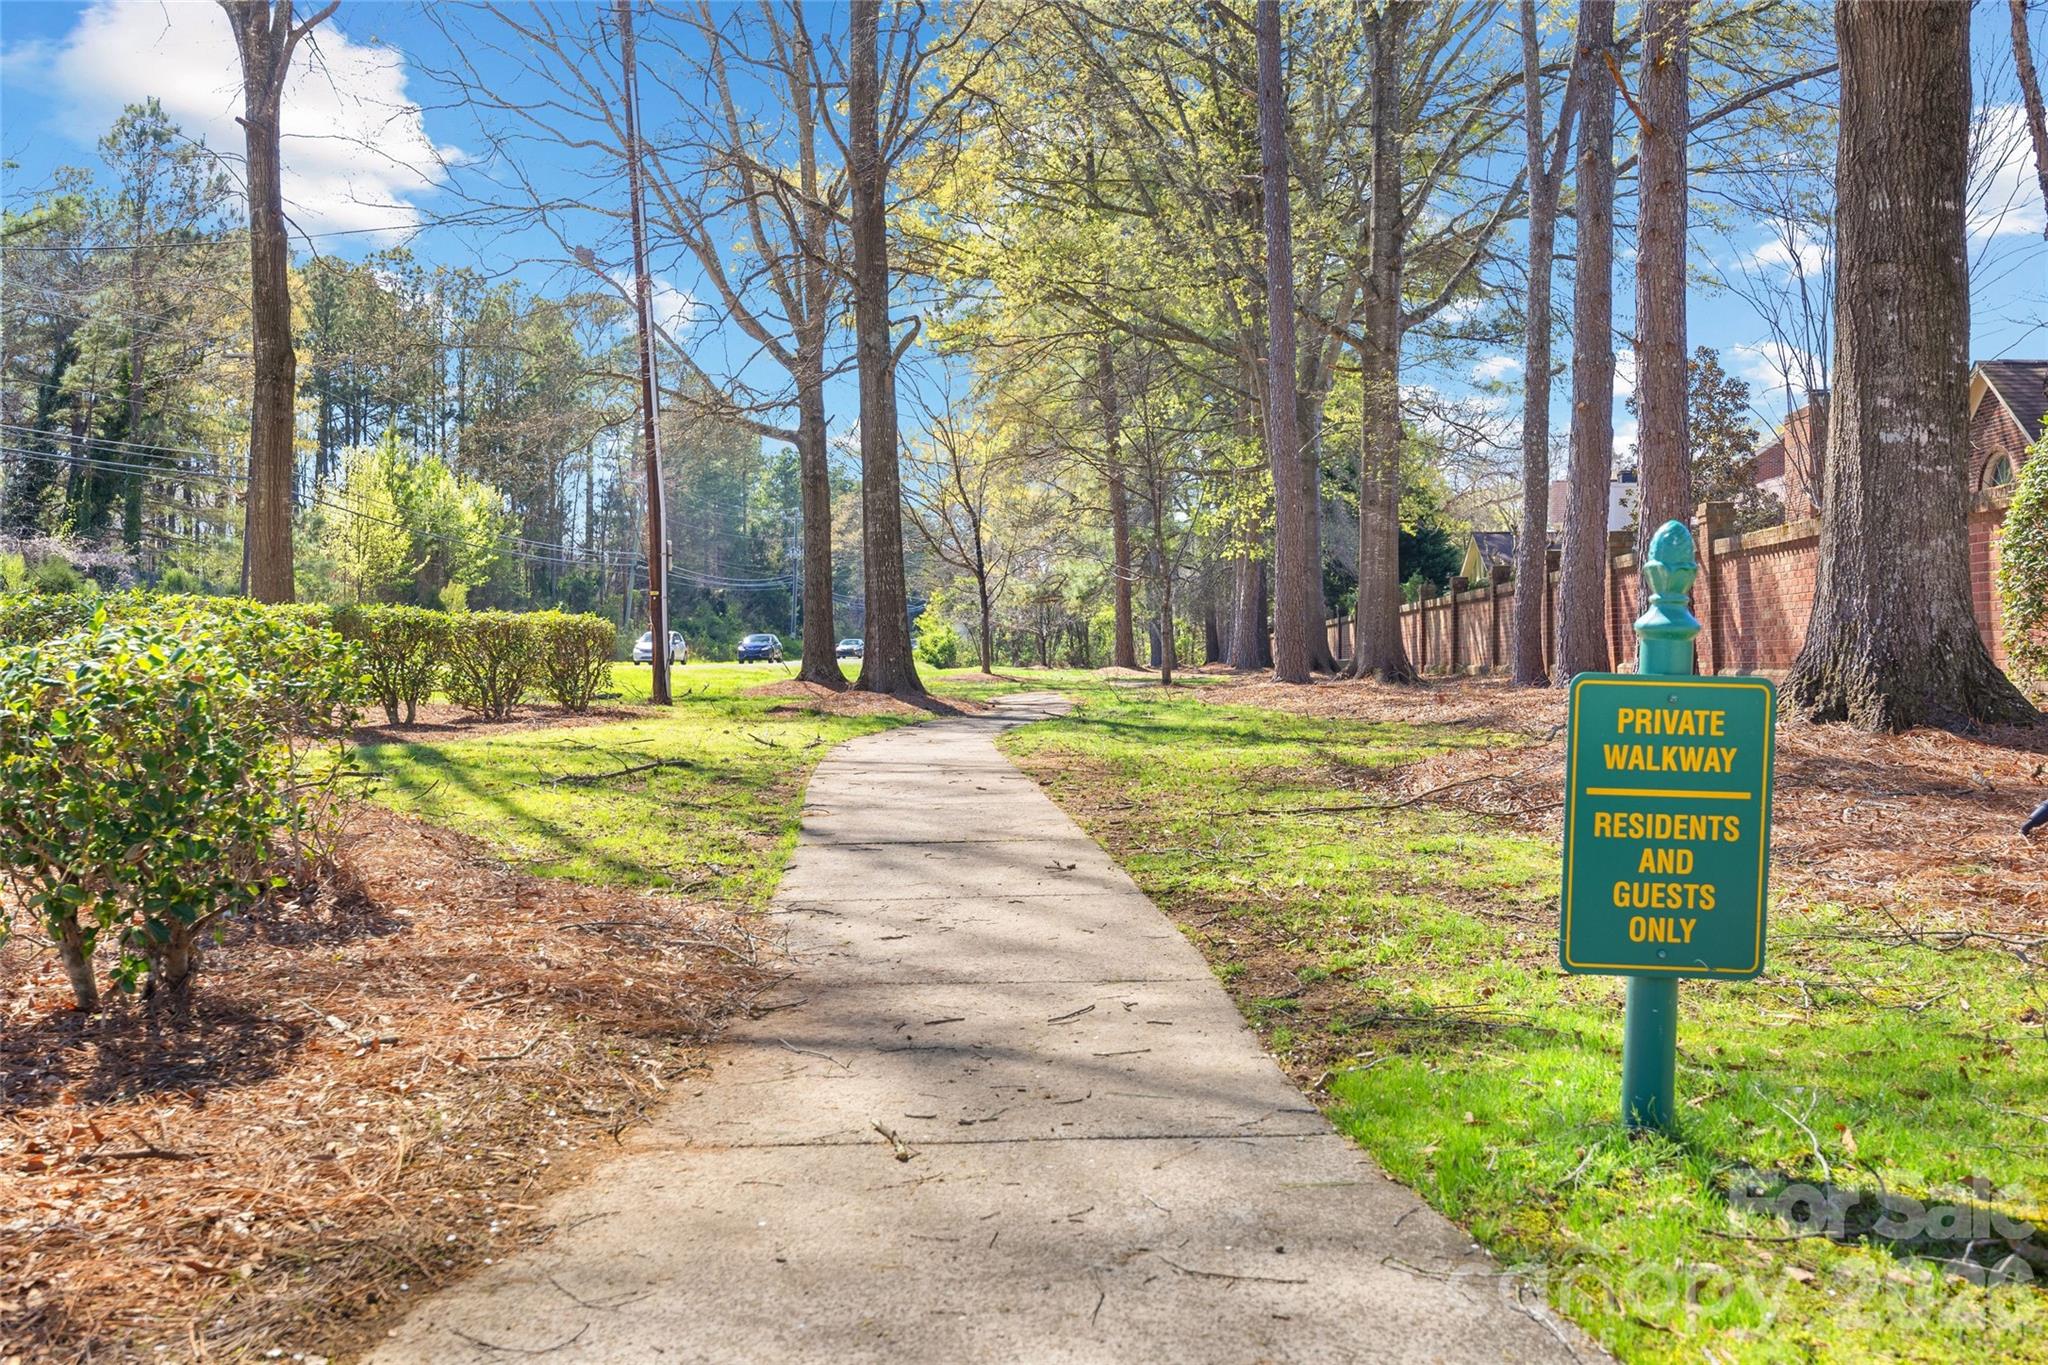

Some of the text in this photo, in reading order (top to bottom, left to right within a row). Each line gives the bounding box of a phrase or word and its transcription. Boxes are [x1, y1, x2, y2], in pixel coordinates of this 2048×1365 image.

[1617, 708, 1725, 736] PRIVATE
[1603, 744, 1738, 772] WALKWAY
[1594, 812, 1740, 842] RESIDENTS
[1638, 848, 1694, 875] AND
[1613, 882, 1716, 910] GUESTS
[1629, 916, 1696, 943] ONLY
